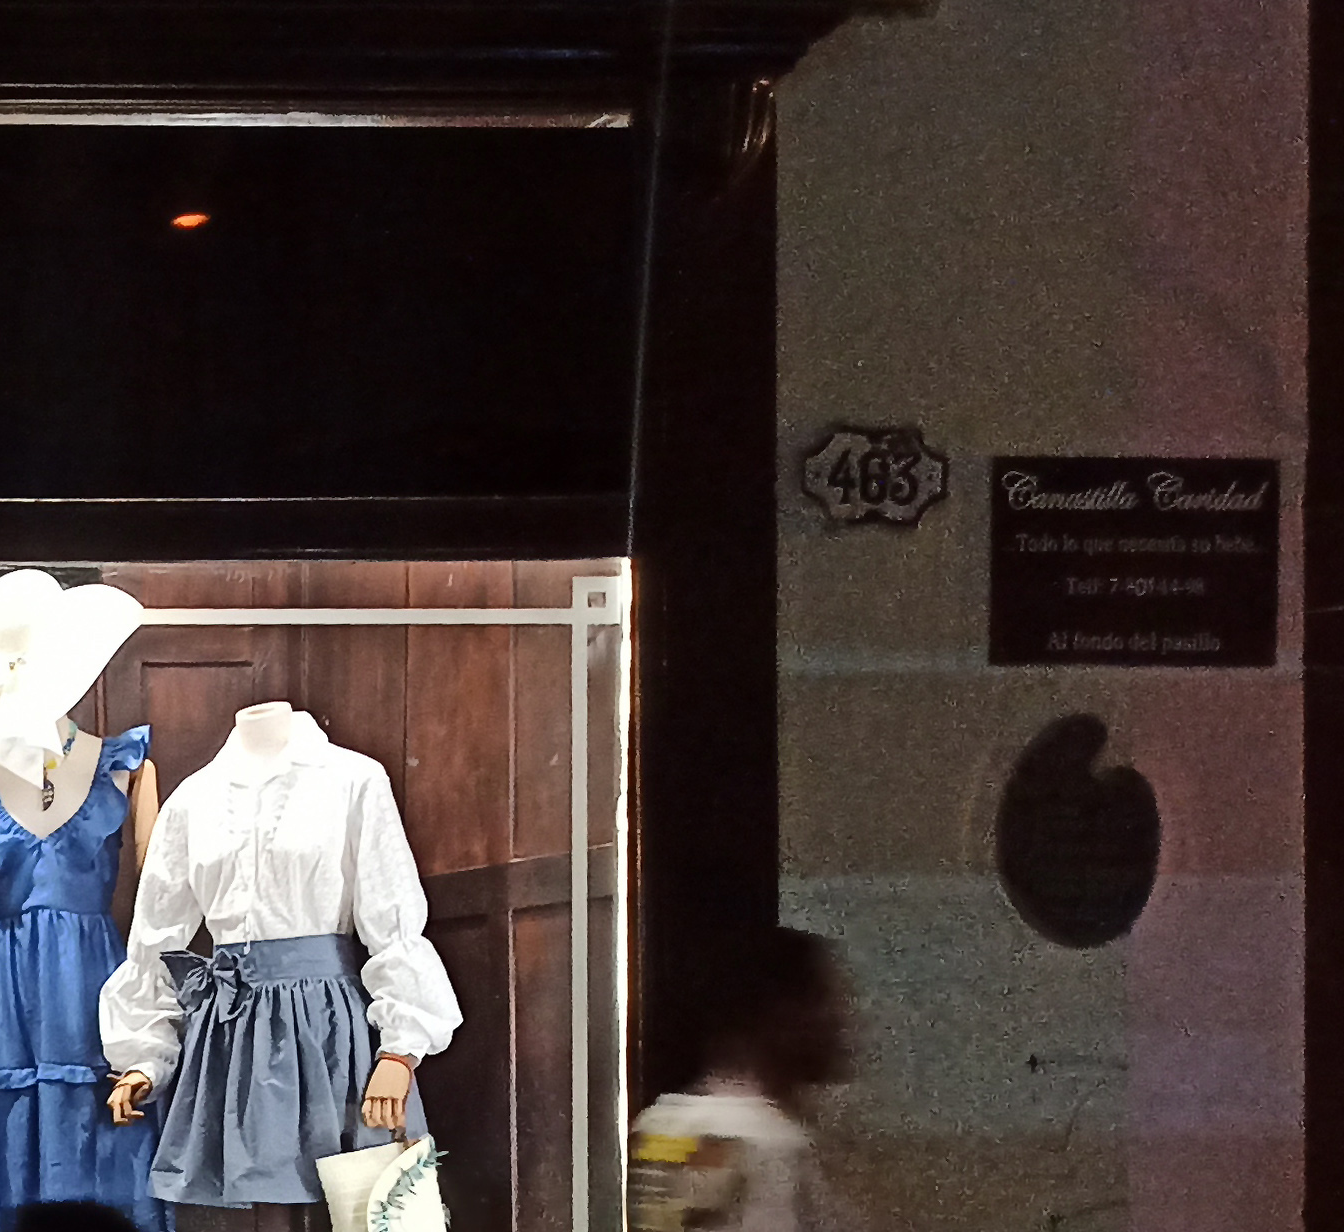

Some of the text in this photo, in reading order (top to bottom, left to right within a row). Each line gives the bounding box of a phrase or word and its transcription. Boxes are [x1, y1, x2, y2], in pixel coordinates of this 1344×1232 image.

[827, 448, 922, 506] 463
[1146, 470, 1270, 512] Caridad
[1073, 631, 1124, 650] fondo
[1128, 631, 1158, 650] del
[1162, 631, 1221, 656] pasillo
